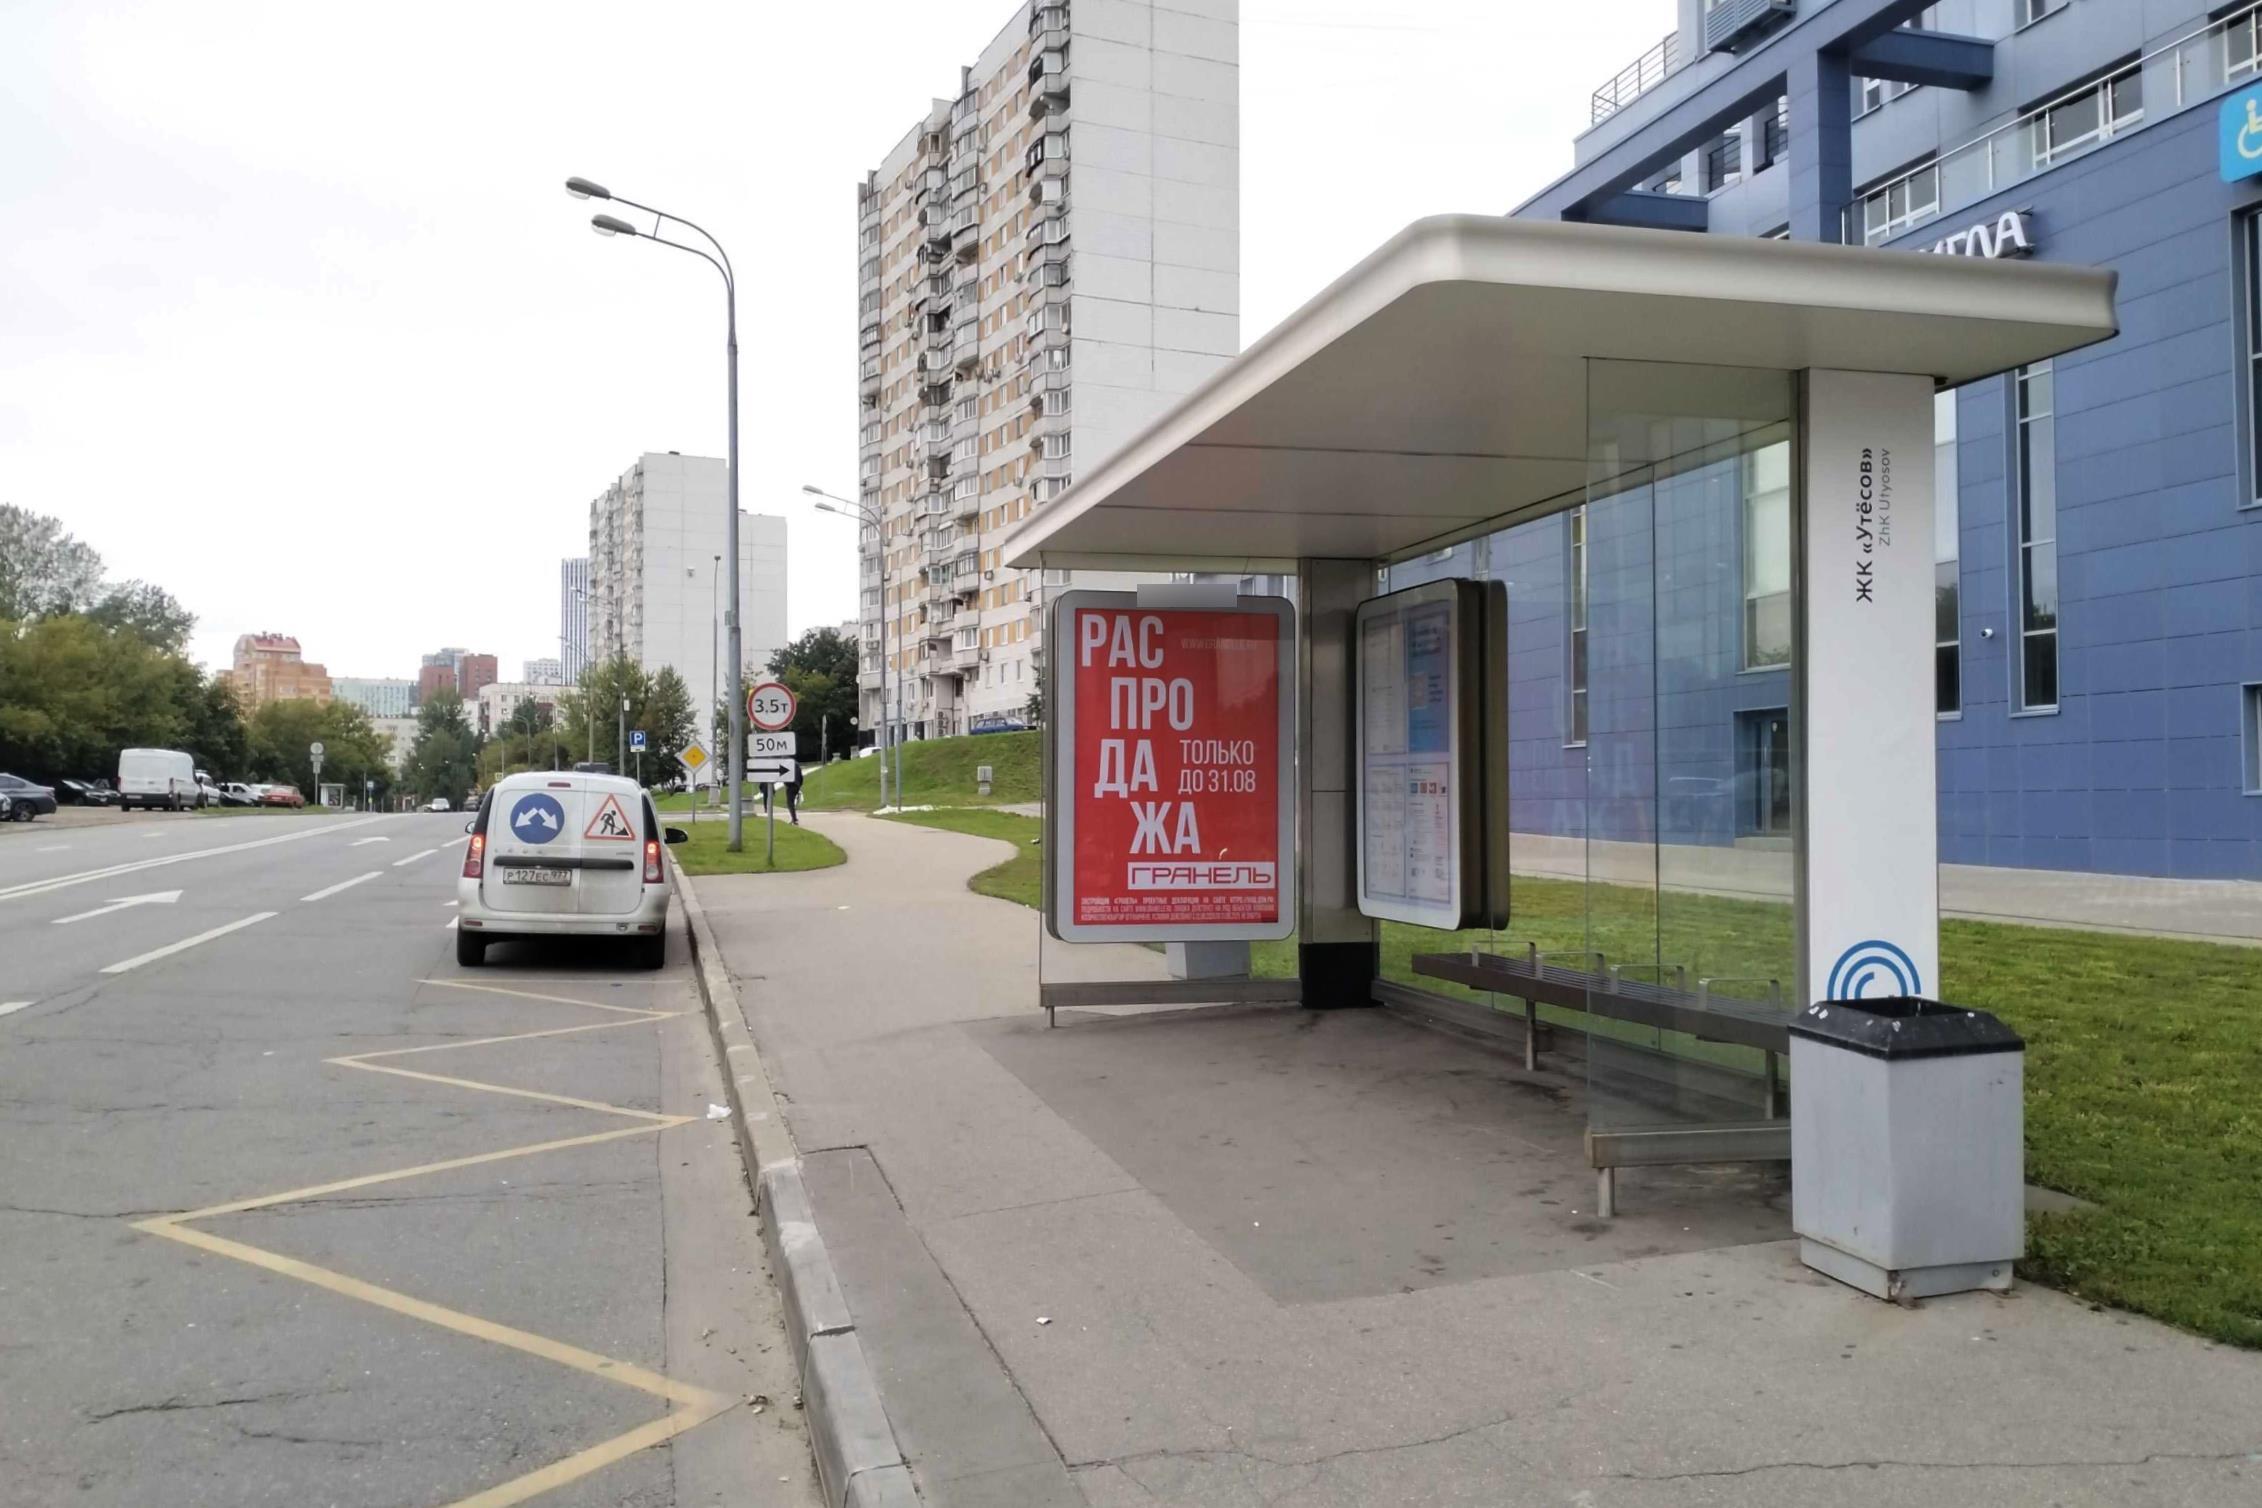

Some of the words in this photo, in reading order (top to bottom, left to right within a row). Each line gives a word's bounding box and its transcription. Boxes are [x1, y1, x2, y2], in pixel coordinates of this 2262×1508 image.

[1855, 447, 1873, 554] «Утёсов»
[1879, 447, 1893, 511] Utyosov
[1879, 514, 1891, 547] ZhK
[1856, 560, 1873, 603] ЖК
[1081, 613, 1164, 669] РАС
[1110, 676, 1194, 732] ПРО
[1094, 738, 1159, 799] ДА
[1179, 738, 1255, 766] ТОЛЬКО
[1178, 769, 1204, 795] ДО
[1208, 769, 1256, 793] 31.08
[1129, 801, 1201, 855] ЖА
[1131, 866, 1272, 885] ГРАНЕЛЬ
